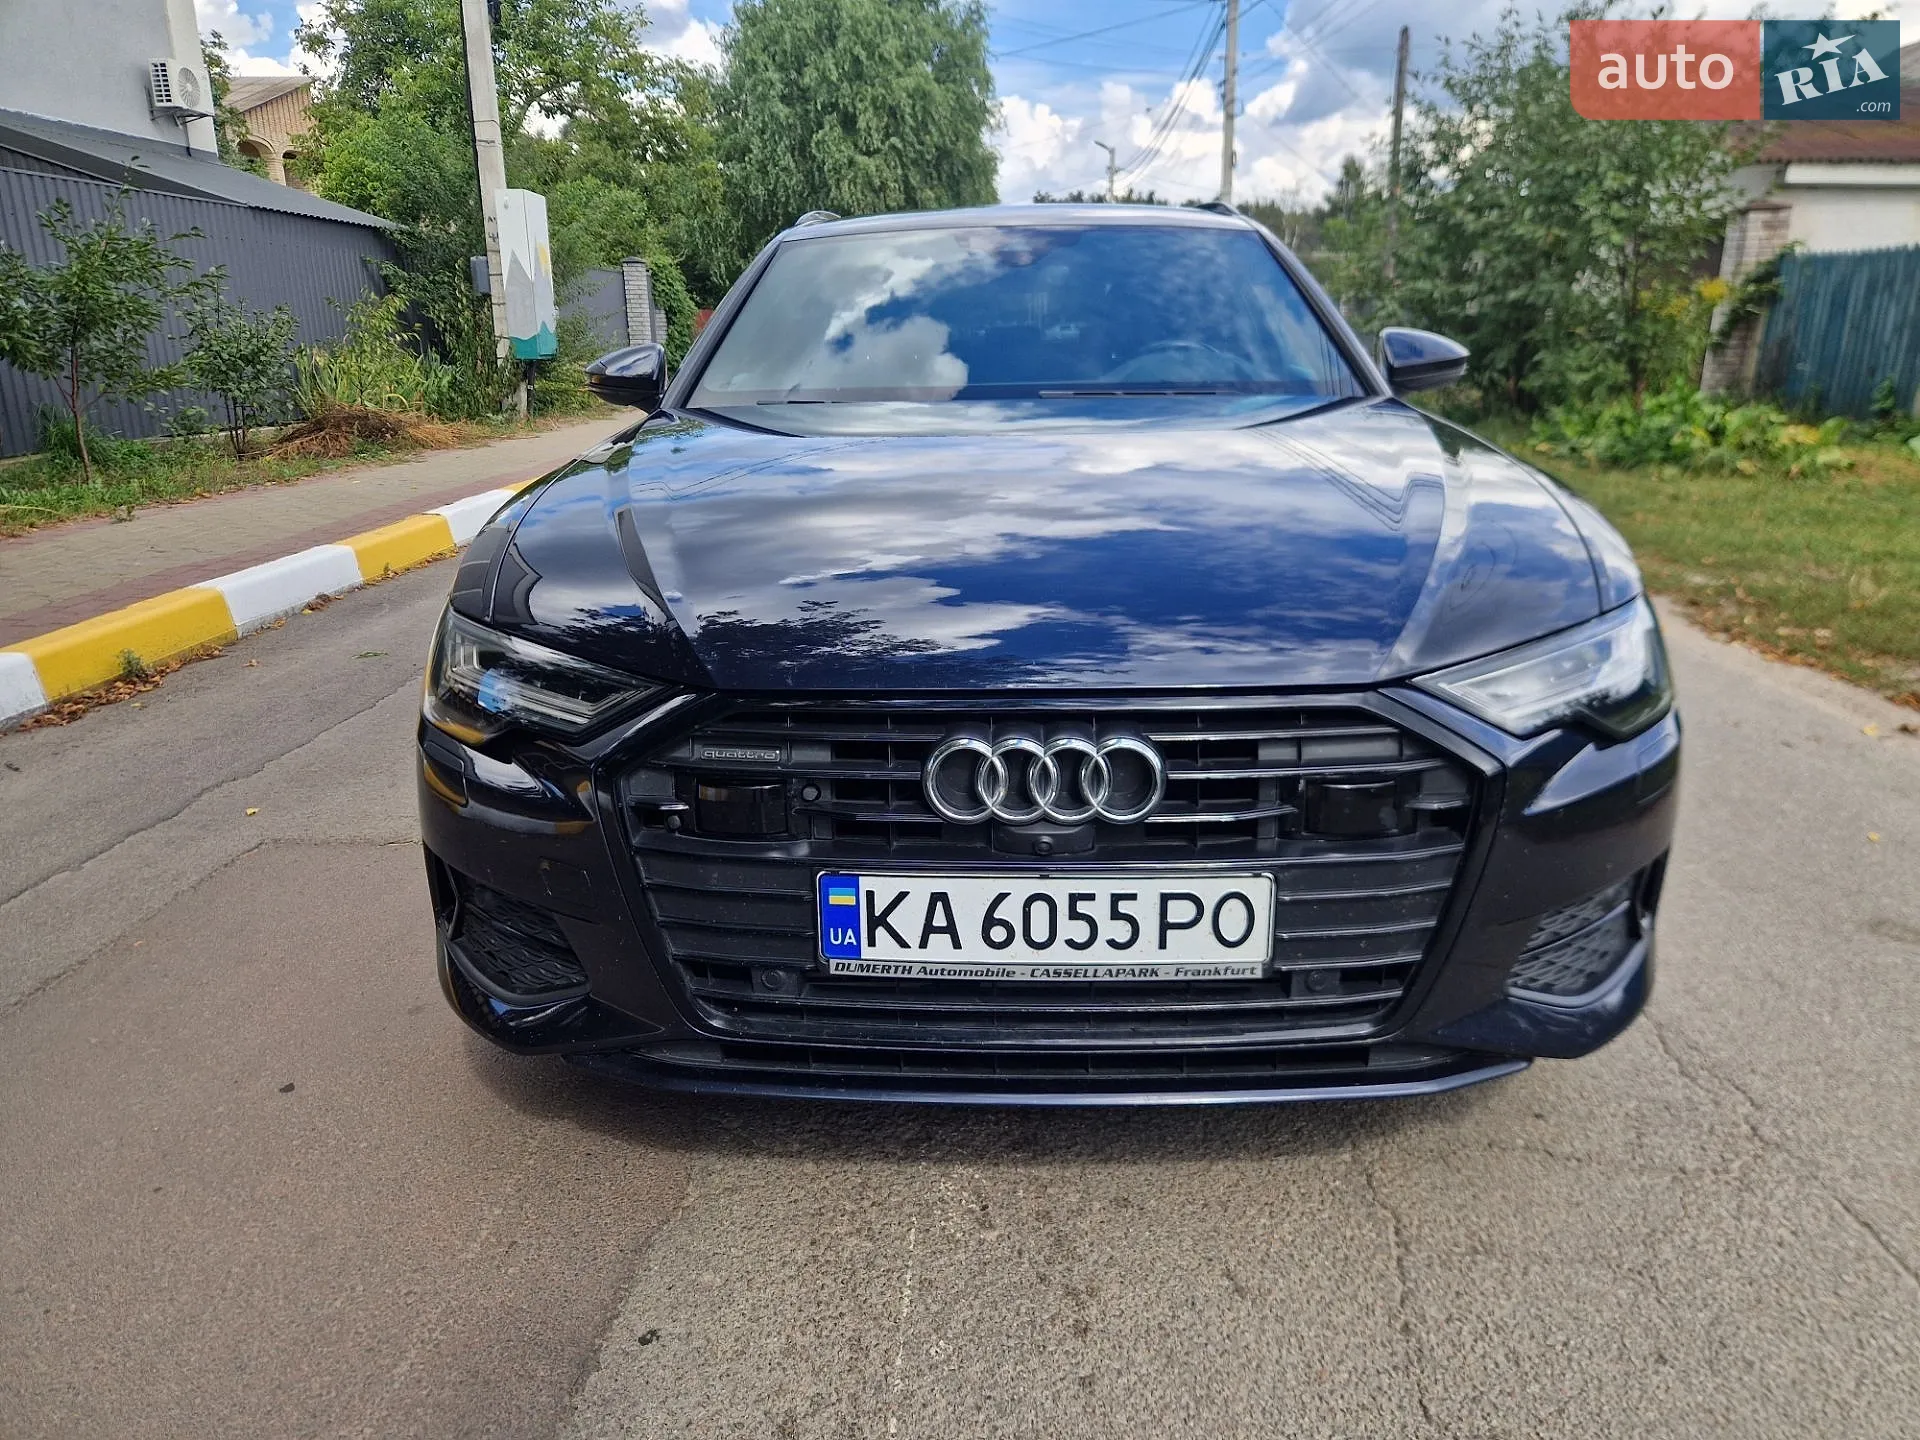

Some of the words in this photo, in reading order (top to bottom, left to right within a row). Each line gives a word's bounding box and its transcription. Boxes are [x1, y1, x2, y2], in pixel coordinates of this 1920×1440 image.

[704, 750, 776, 759] quattro
[865, 890, 963, 950] KA
[981, 891, 1139, 951] 6055
[1158, 891, 1256, 950] PO
[830, 928, 857, 945] UA
[917, 968, 1016, 978] Automobile
[1030, 968, 1160, 978] CASSELLAPARK
[1175, 966, 1257, 977] Frankfurt
